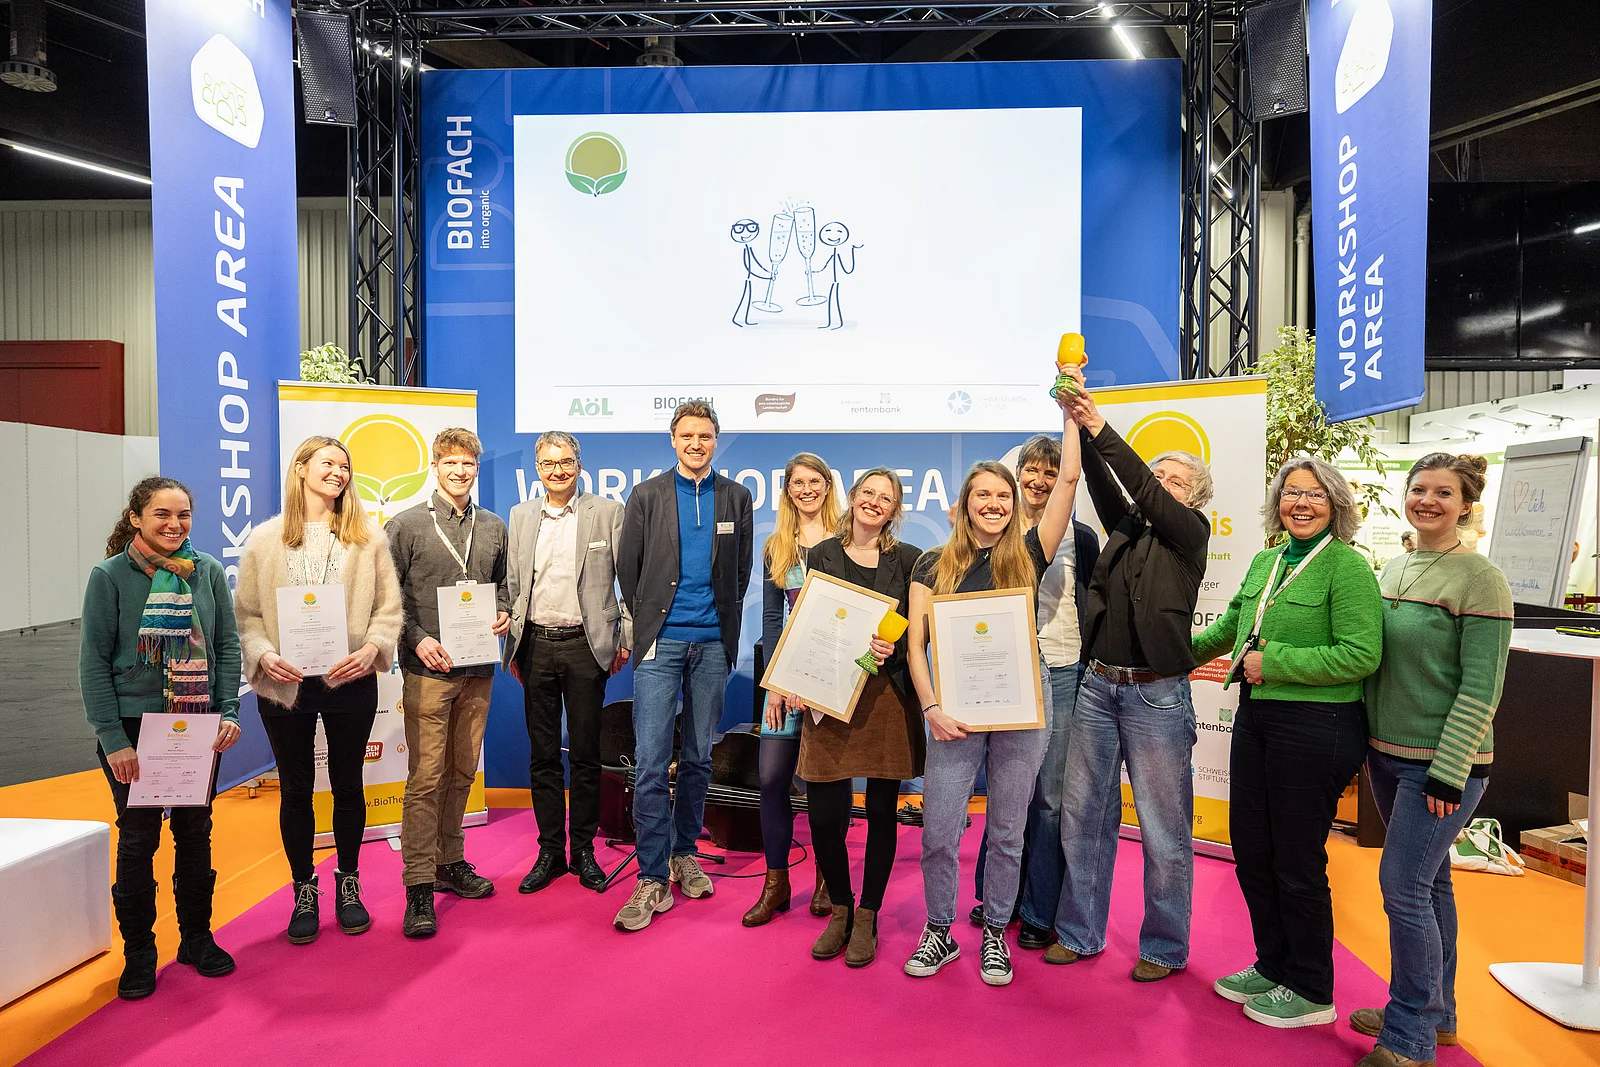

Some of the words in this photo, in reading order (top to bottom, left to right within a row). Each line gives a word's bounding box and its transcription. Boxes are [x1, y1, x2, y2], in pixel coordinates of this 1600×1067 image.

[446, 115, 473, 249] BIOFACH
[480, 189, 492, 227] organic
[213, 175, 249, 338] AREA
[480, 228, 490, 249] into
[1337, 134, 1360, 392] WORKSHOP
[1363, 253, 1385, 381] AREA
[851, 406, 901, 414] rentenbank
[216, 350, 254, 698] RKSHOP
[366, 744, 380, 752] SEN
[1195, 722, 1232, 734] ntenba
